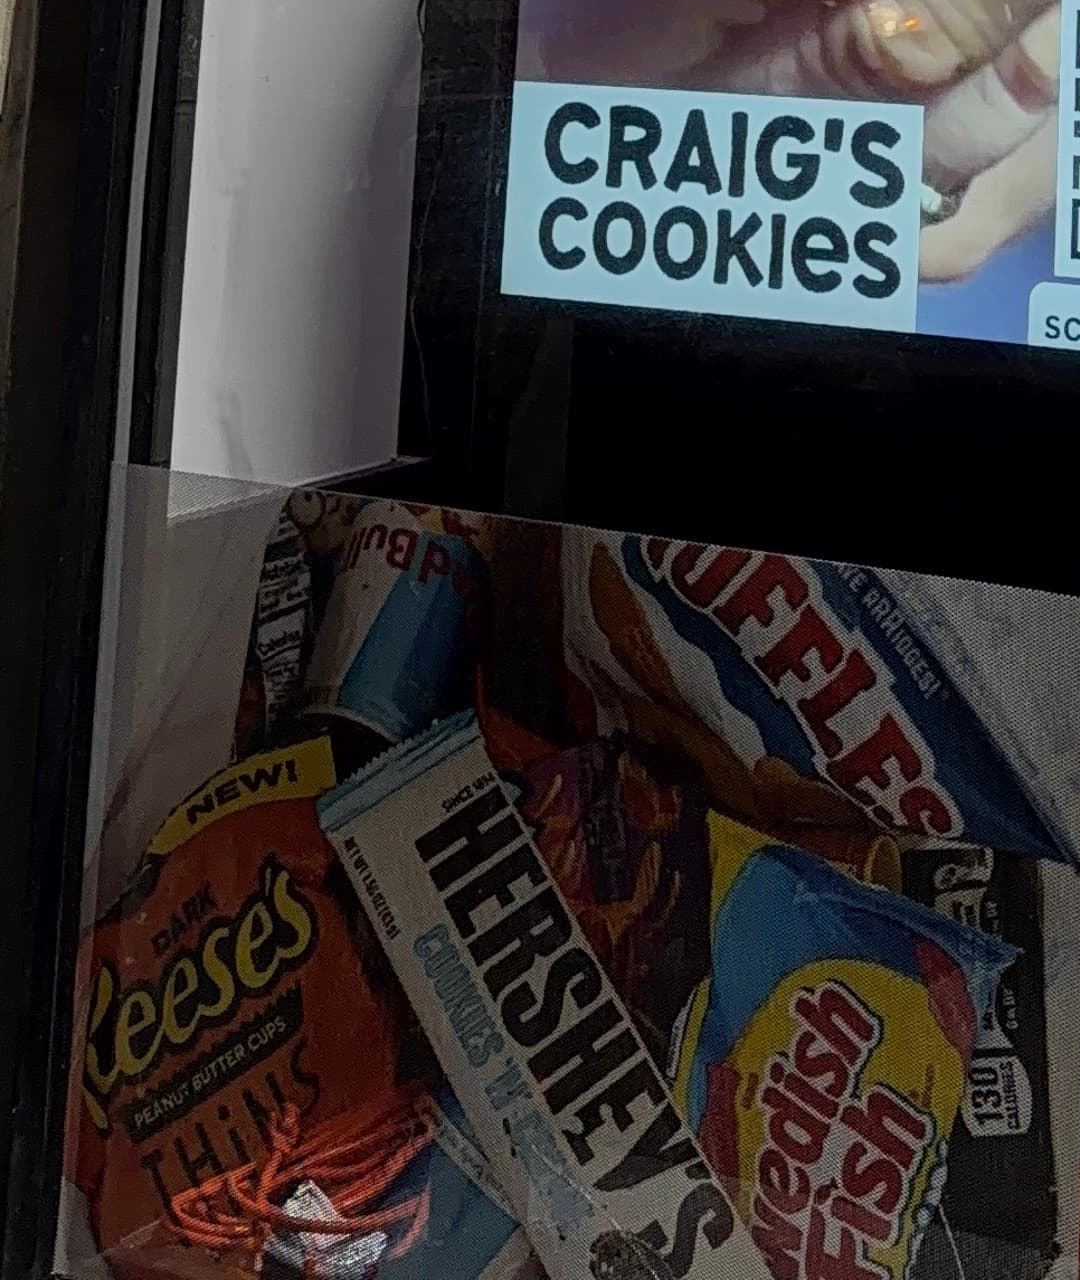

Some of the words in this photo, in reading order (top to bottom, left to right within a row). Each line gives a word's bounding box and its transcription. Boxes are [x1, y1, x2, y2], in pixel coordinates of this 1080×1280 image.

[544, 101, 906, 210] CRAIG'S
[184, 759, 299, 825] NEW!
[151, 882, 218, 957] DARK
[133, 1080, 190, 1128] PEANUT
[192, 1043, 248, 1093] BUTTER
[246, 1013, 288, 1053] CUPS
[969, 1066, 1004, 1127] 130
